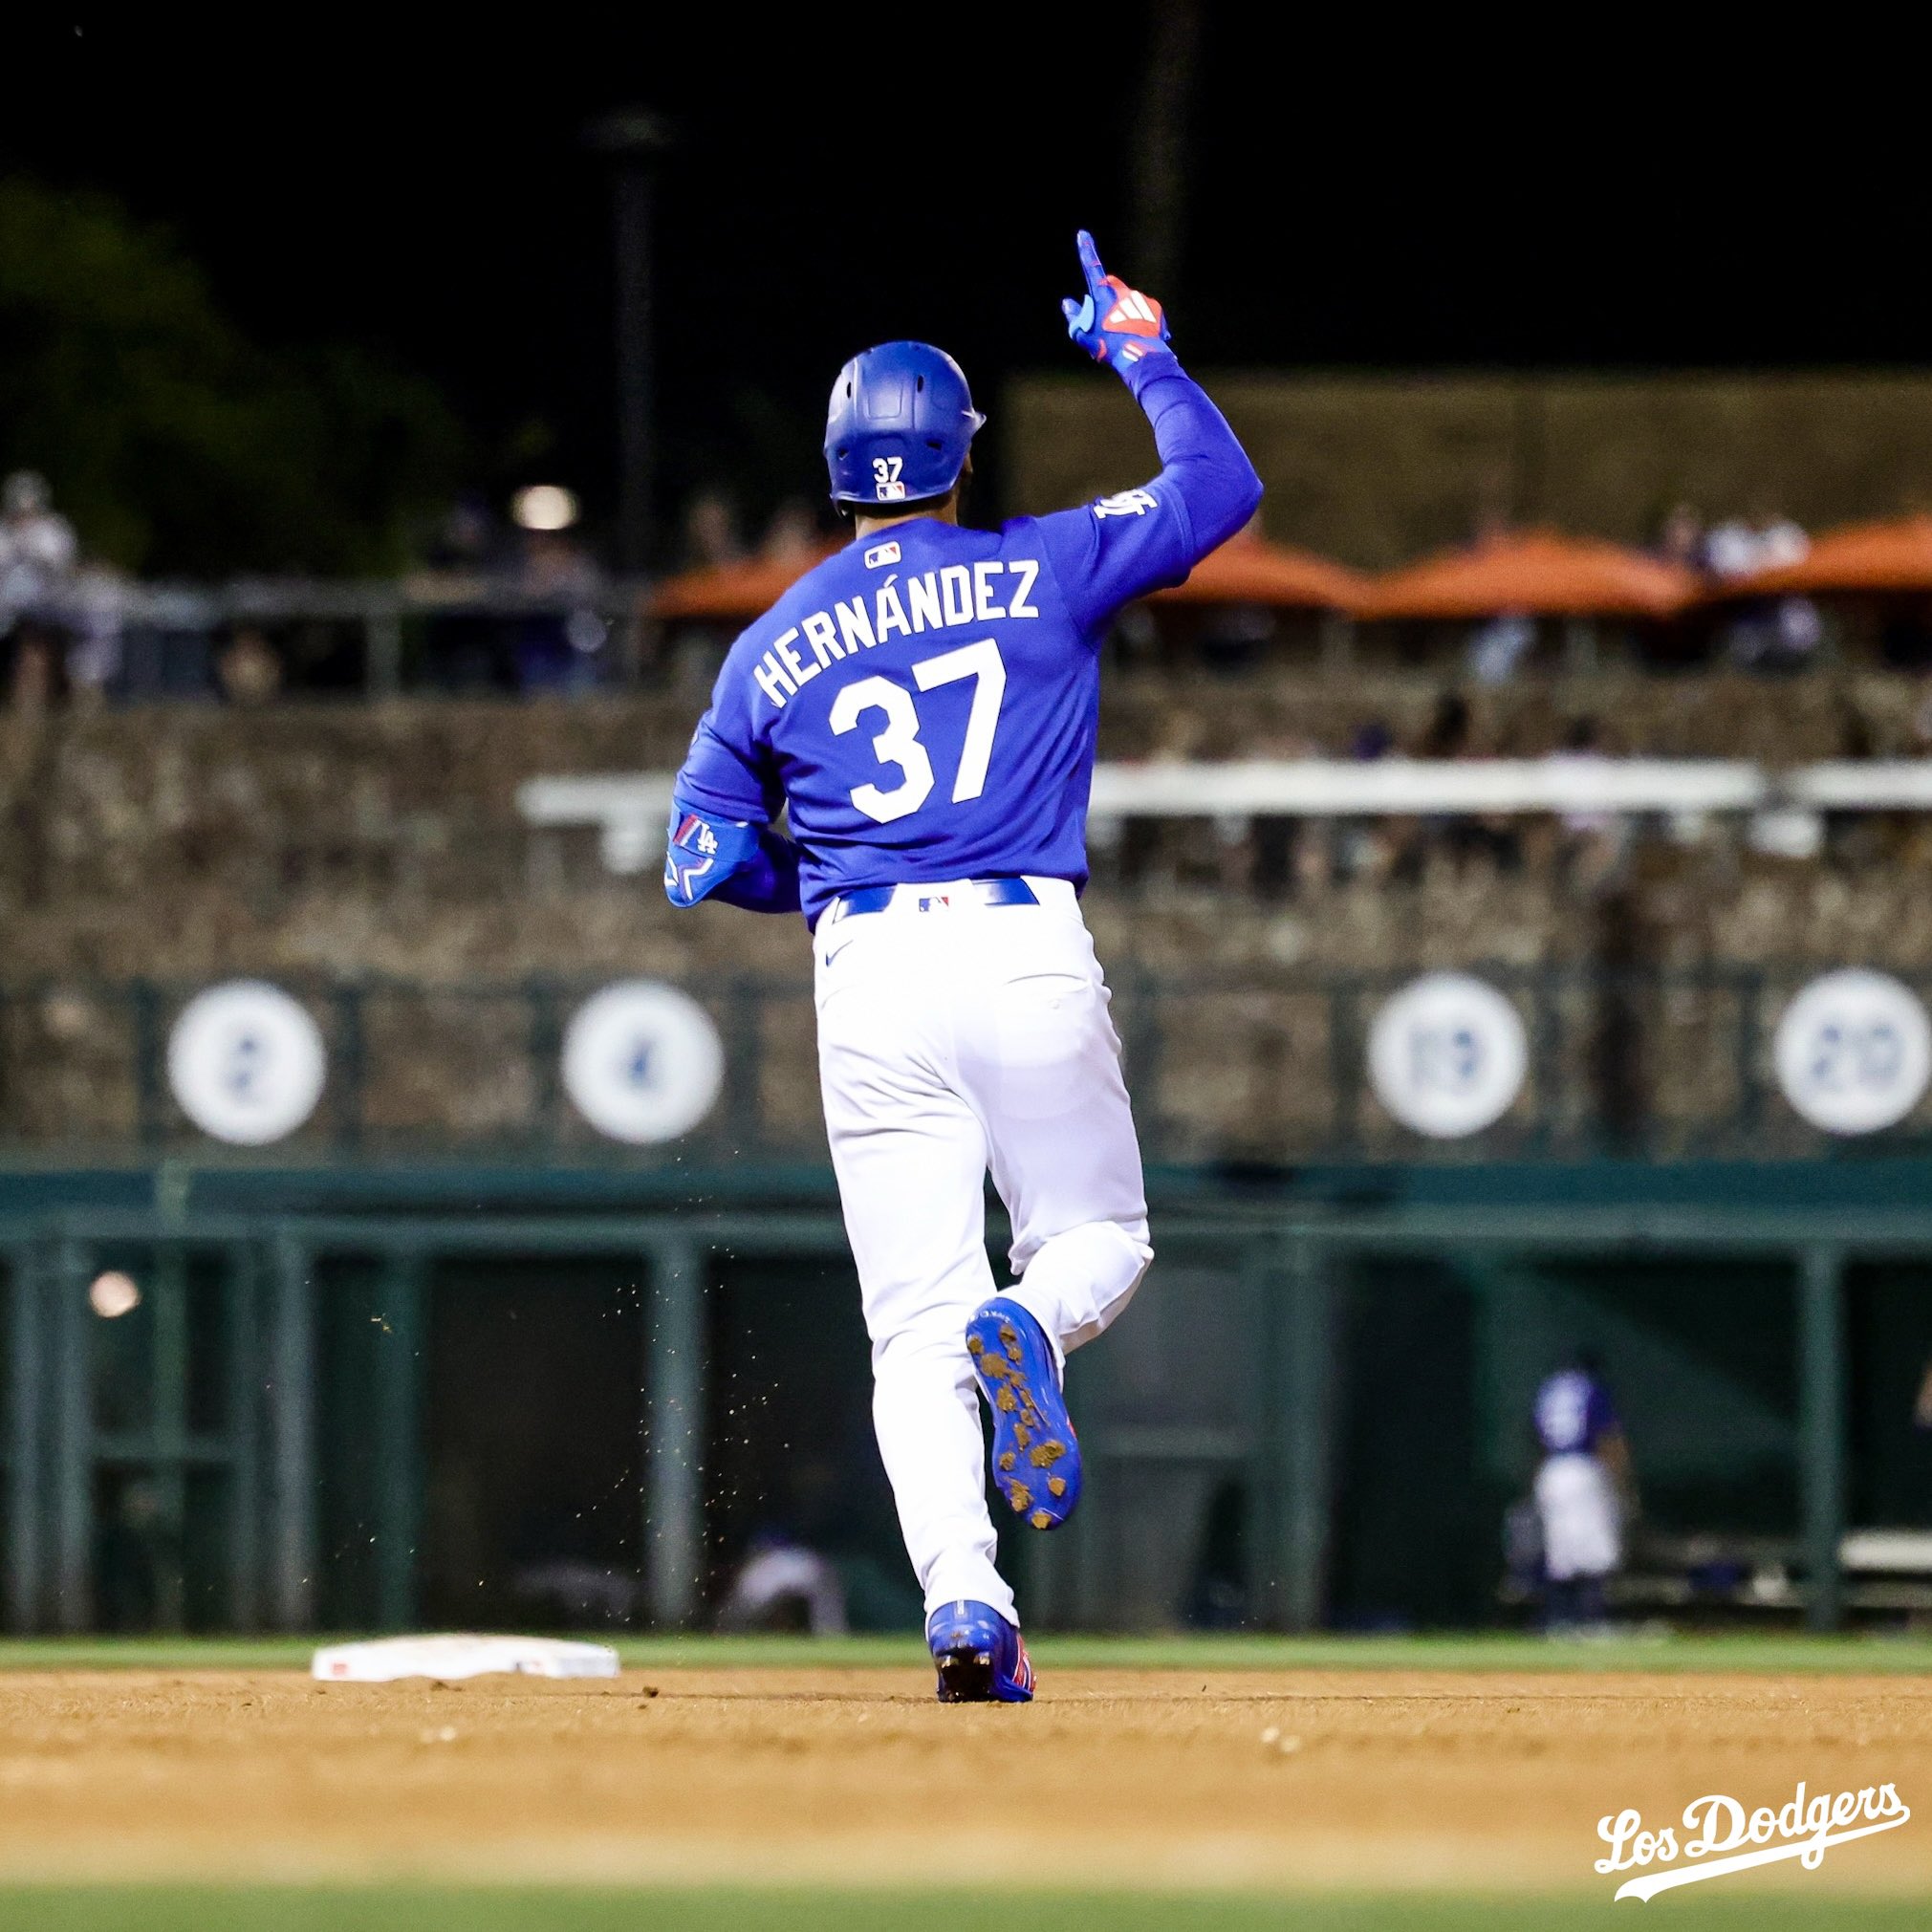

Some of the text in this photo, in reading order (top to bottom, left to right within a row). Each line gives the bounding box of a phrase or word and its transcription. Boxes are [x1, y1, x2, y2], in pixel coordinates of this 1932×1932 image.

[873, 457, 903, 483] 37
[753, 560, 1039, 708] HERNÁNDEZ
[829, 638, 1007, 824] 37
[697, 823, 718, 855] LA
[1806, 1019, 1909, 1097] 20
